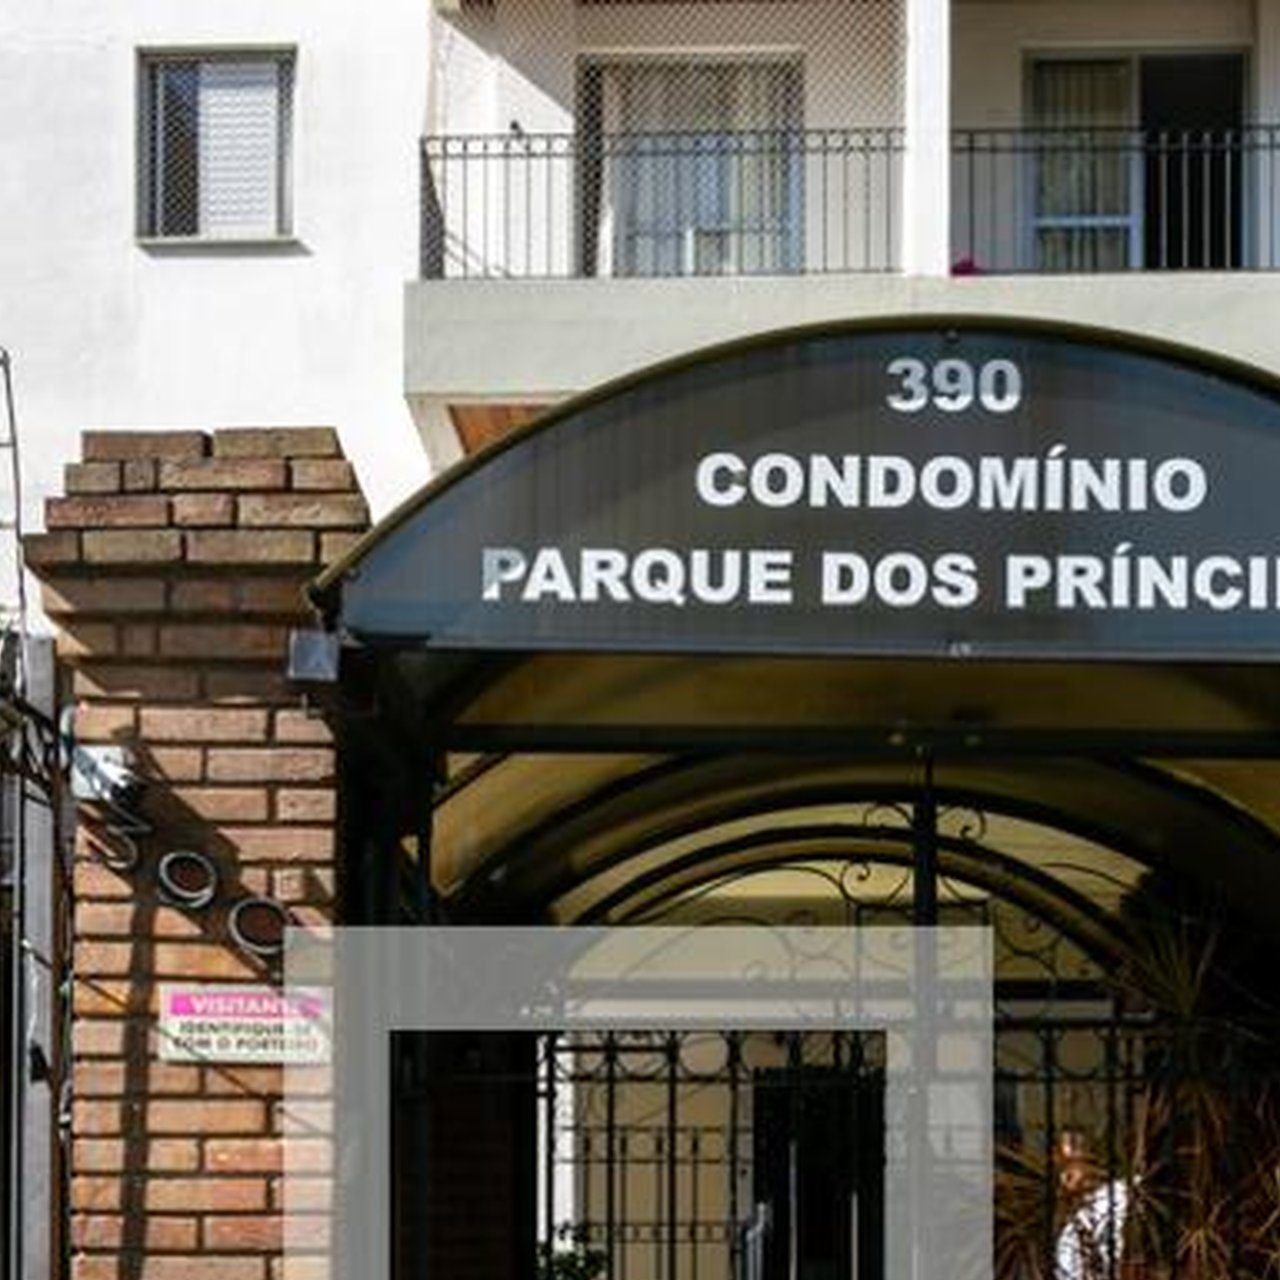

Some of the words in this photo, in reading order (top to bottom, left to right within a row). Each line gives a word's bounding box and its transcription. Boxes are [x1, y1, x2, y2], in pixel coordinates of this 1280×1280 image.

[886, 357, 1021, 414] 390
[694, 443, 1208, 513] CONDOMÍNIO
[480, 546, 793, 607] PARQUE
[820, 550, 979, 608] DOS
